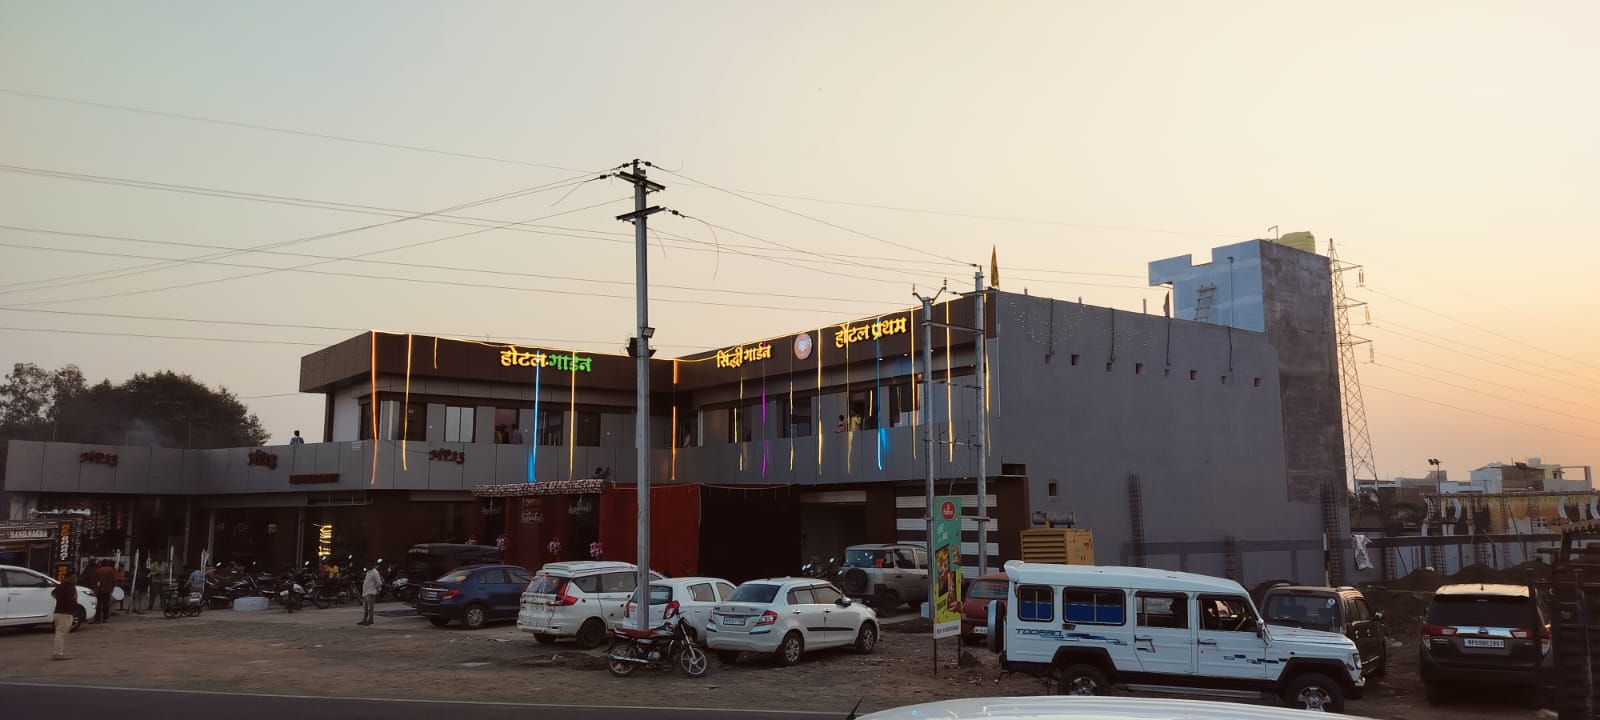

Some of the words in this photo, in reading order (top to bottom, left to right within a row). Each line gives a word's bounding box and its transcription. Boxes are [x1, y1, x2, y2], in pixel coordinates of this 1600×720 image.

[835, 324, 870, 348] होटल
[871, 317, 907, 340] प्रथम
[500, 345, 548, 367] होटल
[548, 351, 592, 372] गार्डन
